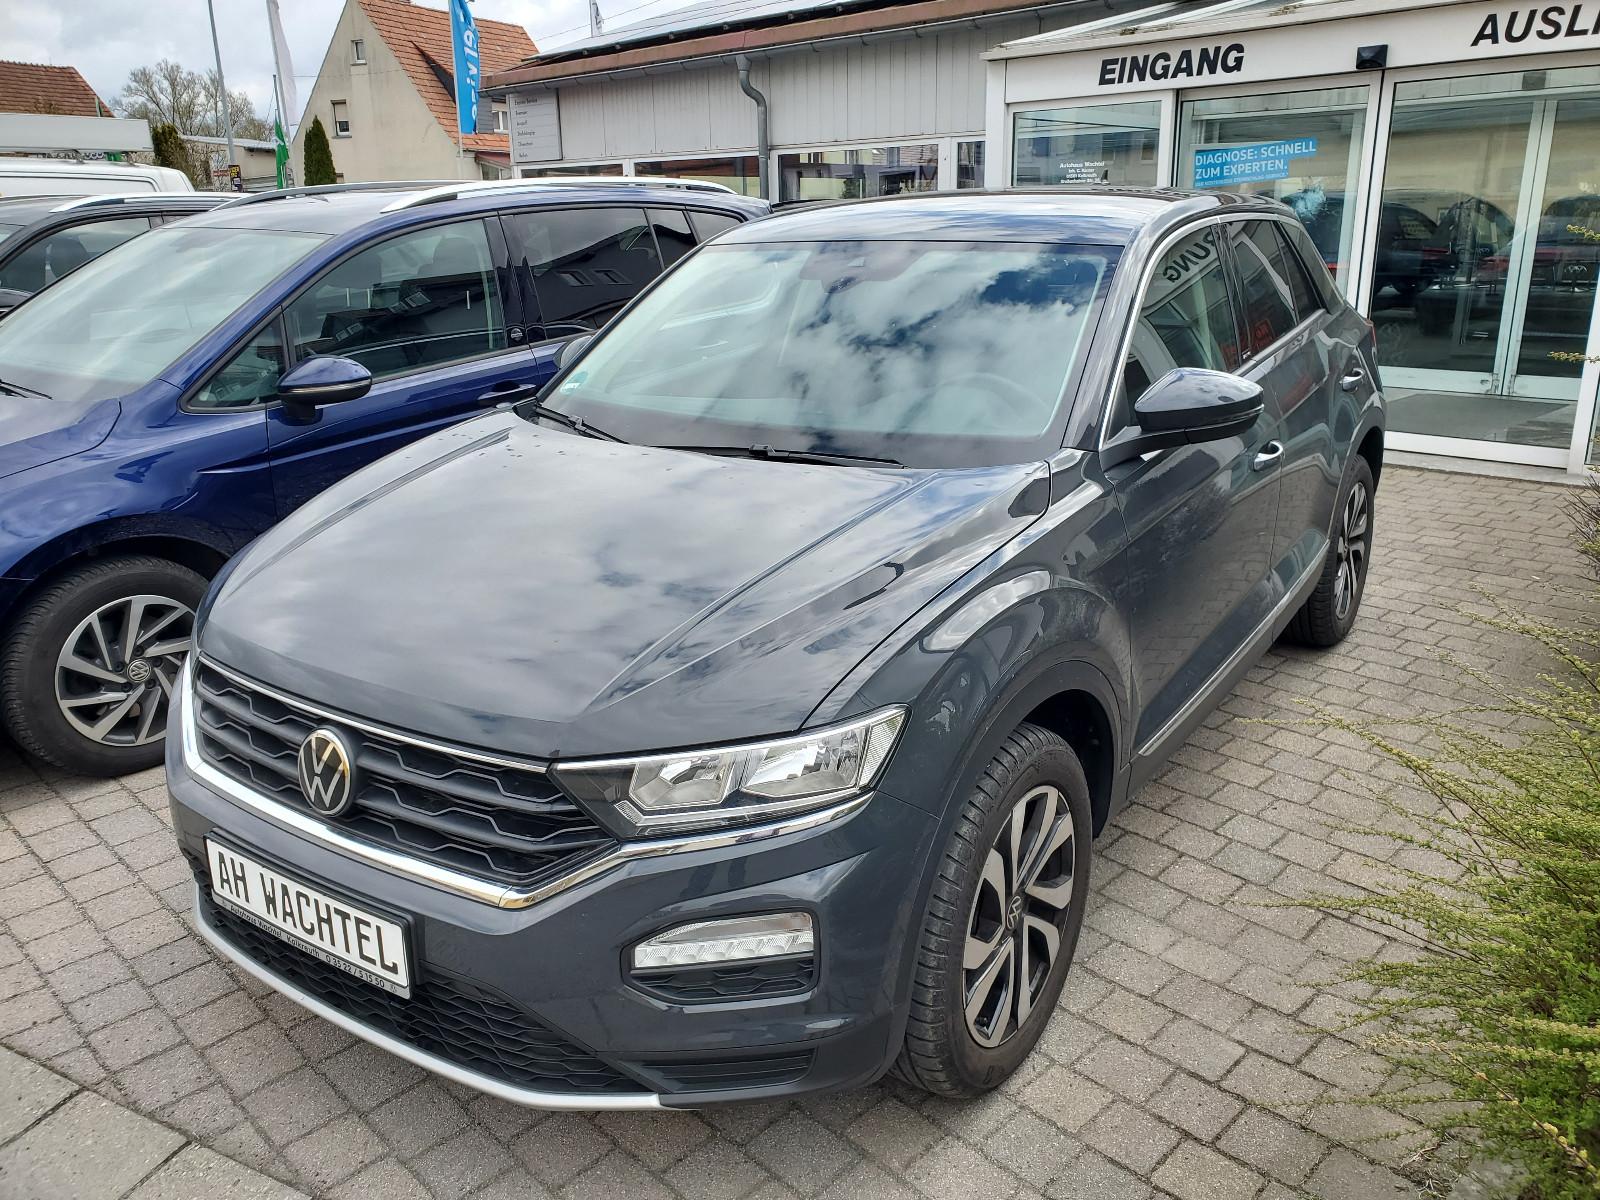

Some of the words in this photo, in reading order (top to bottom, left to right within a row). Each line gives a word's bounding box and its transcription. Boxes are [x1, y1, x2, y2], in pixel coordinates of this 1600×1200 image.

[1099, 43, 1245, 85] EINGANG
[1195, 150, 1258, 166] DIAGNOSE:
[1261, 141, 1316, 158] SCHNELL
[1195, 167, 1220, 180] ZUM
[1223, 160, 1288, 176] EXPERTEN.
[218, 850, 250, 903] AH
[260, 872, 399, 975] WACHTEL
[230, 904, 257, 925] Autohaus
[258, 919, 282, 938] Wachtel
[286, 934, 320, 958] Kalkreuth
[343, 962, 352, 973] 22
